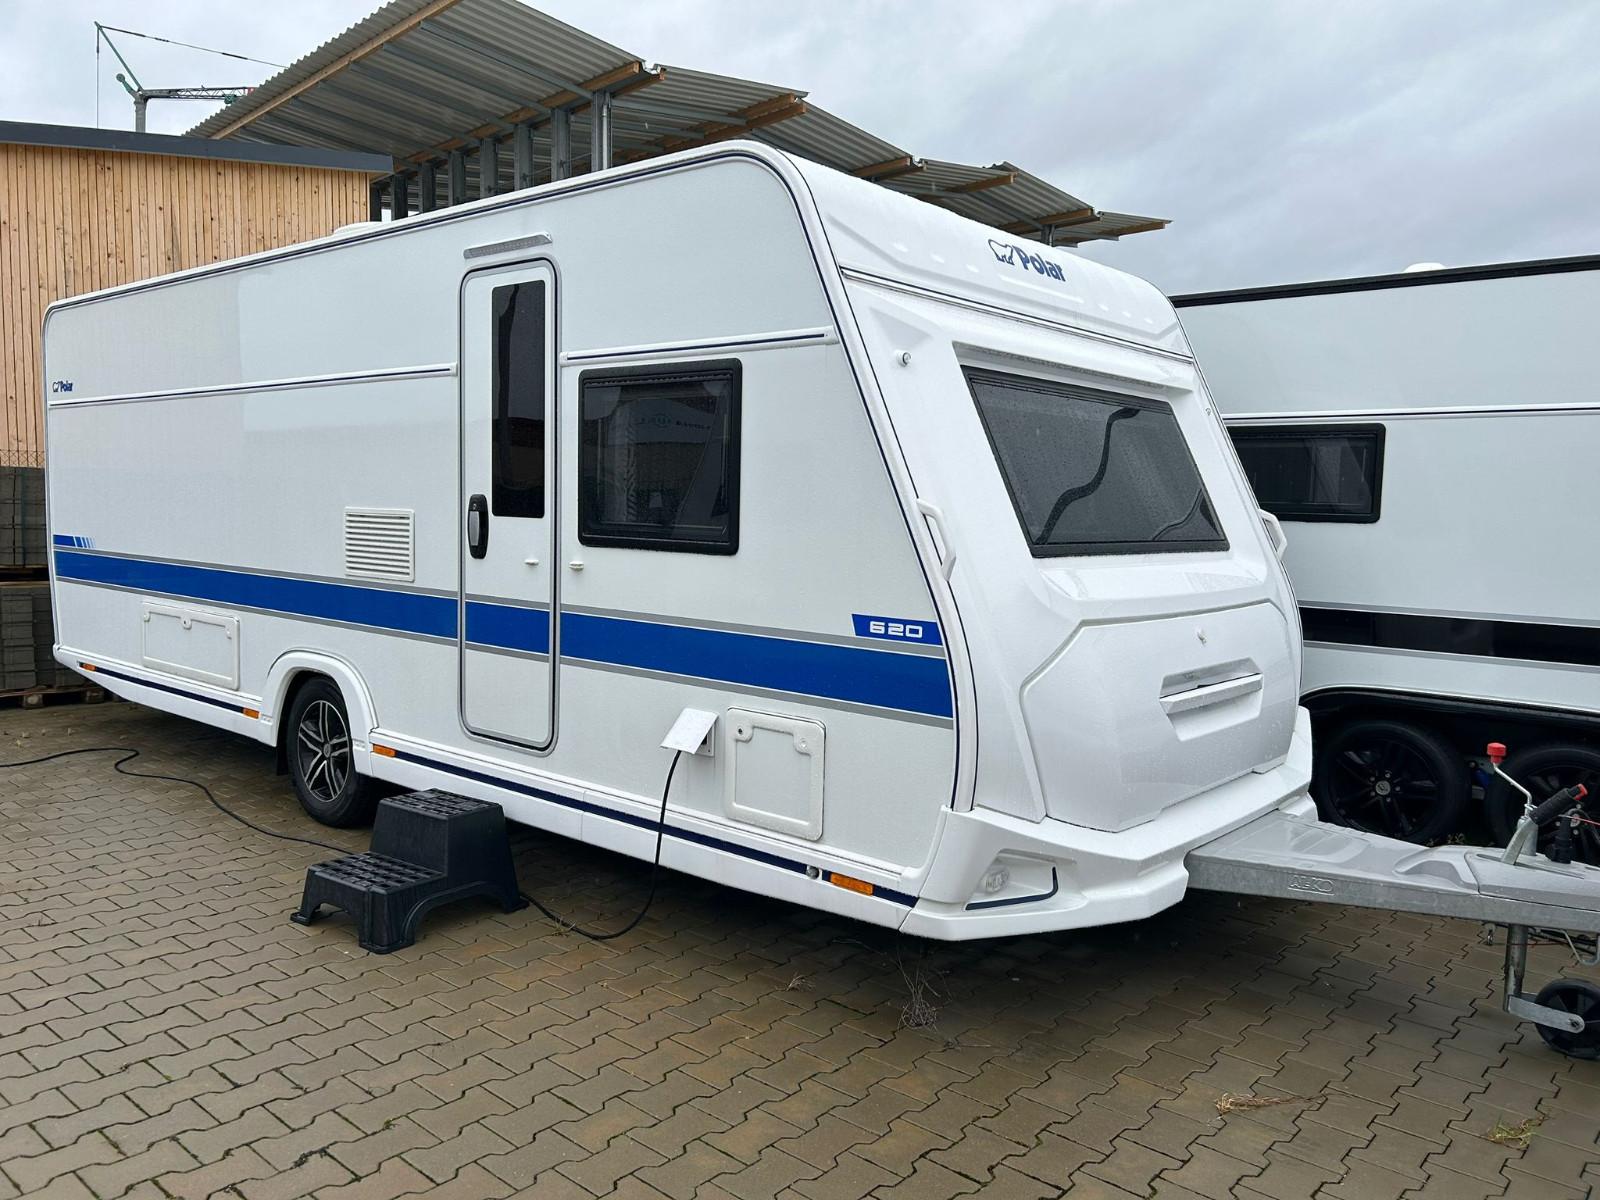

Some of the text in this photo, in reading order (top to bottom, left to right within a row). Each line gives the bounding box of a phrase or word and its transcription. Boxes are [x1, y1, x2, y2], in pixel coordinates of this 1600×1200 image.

[1012, 245, 1066, 282] Polar
[60, 380, 73, 392] Polar
[869, 620, 923, 638] 620
